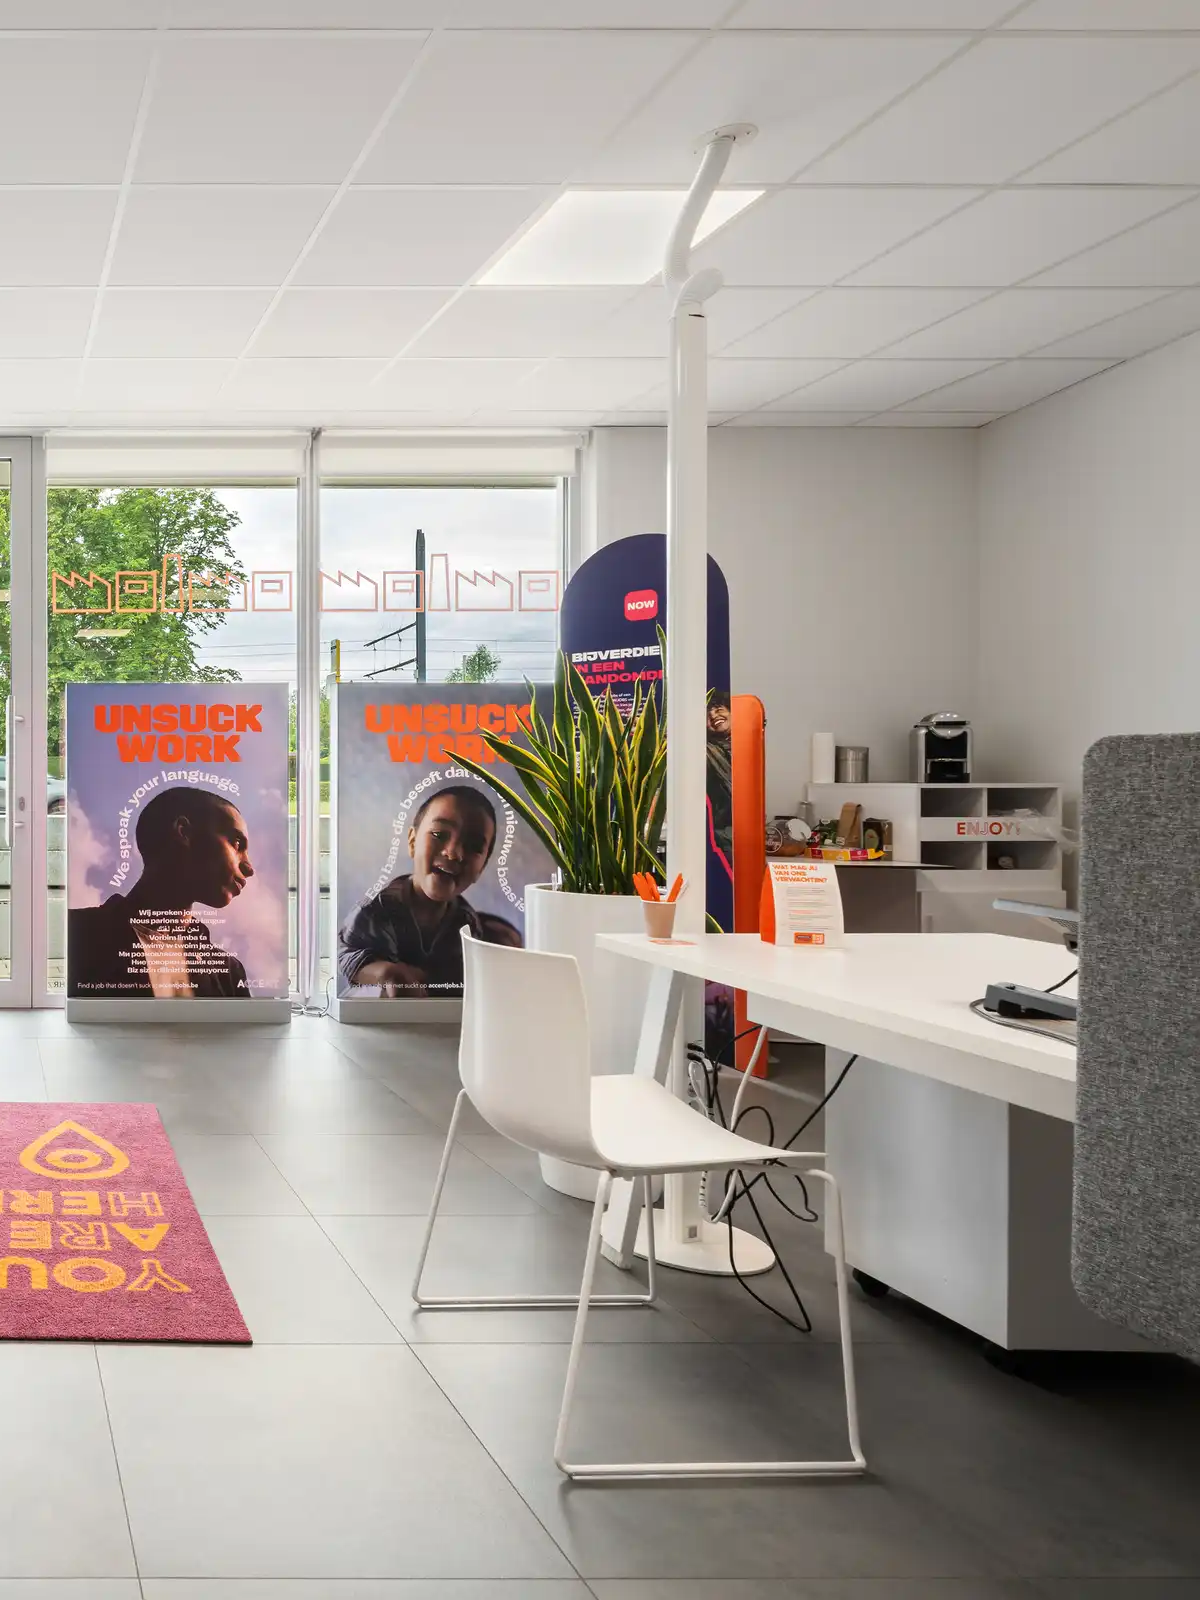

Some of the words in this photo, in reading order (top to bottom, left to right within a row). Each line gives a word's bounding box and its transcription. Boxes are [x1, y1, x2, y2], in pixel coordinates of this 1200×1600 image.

[627, 600, 655, 610] NOW
[572, 645, 661, 662] BIJVERDIE
[592, 660, 625, 673] EEN
[94, 704, 263, 733] UNSUCK
[365, 703, 533, 733] UNSUCK
[116, 734, 242, 763] WORK
[128, 775, 160, 808] your
[161, 769, 241, 797] language.
[400, 771, 443, 811] beseft
[118, 806, 133, 859] speak
[392, 810, 408, 835] die
[497, 810, 519, 866] nieuwe
[380, 837, 401, 878] baas
[109, 862, 130, 888] We
[365, 874, 389, 900] Een
[497, 867, 516, 903] baas
[139, 909, 151, 917] Wij
[152, 909, 182, 917] spreken
[150, 917, 179, 925] parlons
[8, 1220, 171, 1251] ARE
